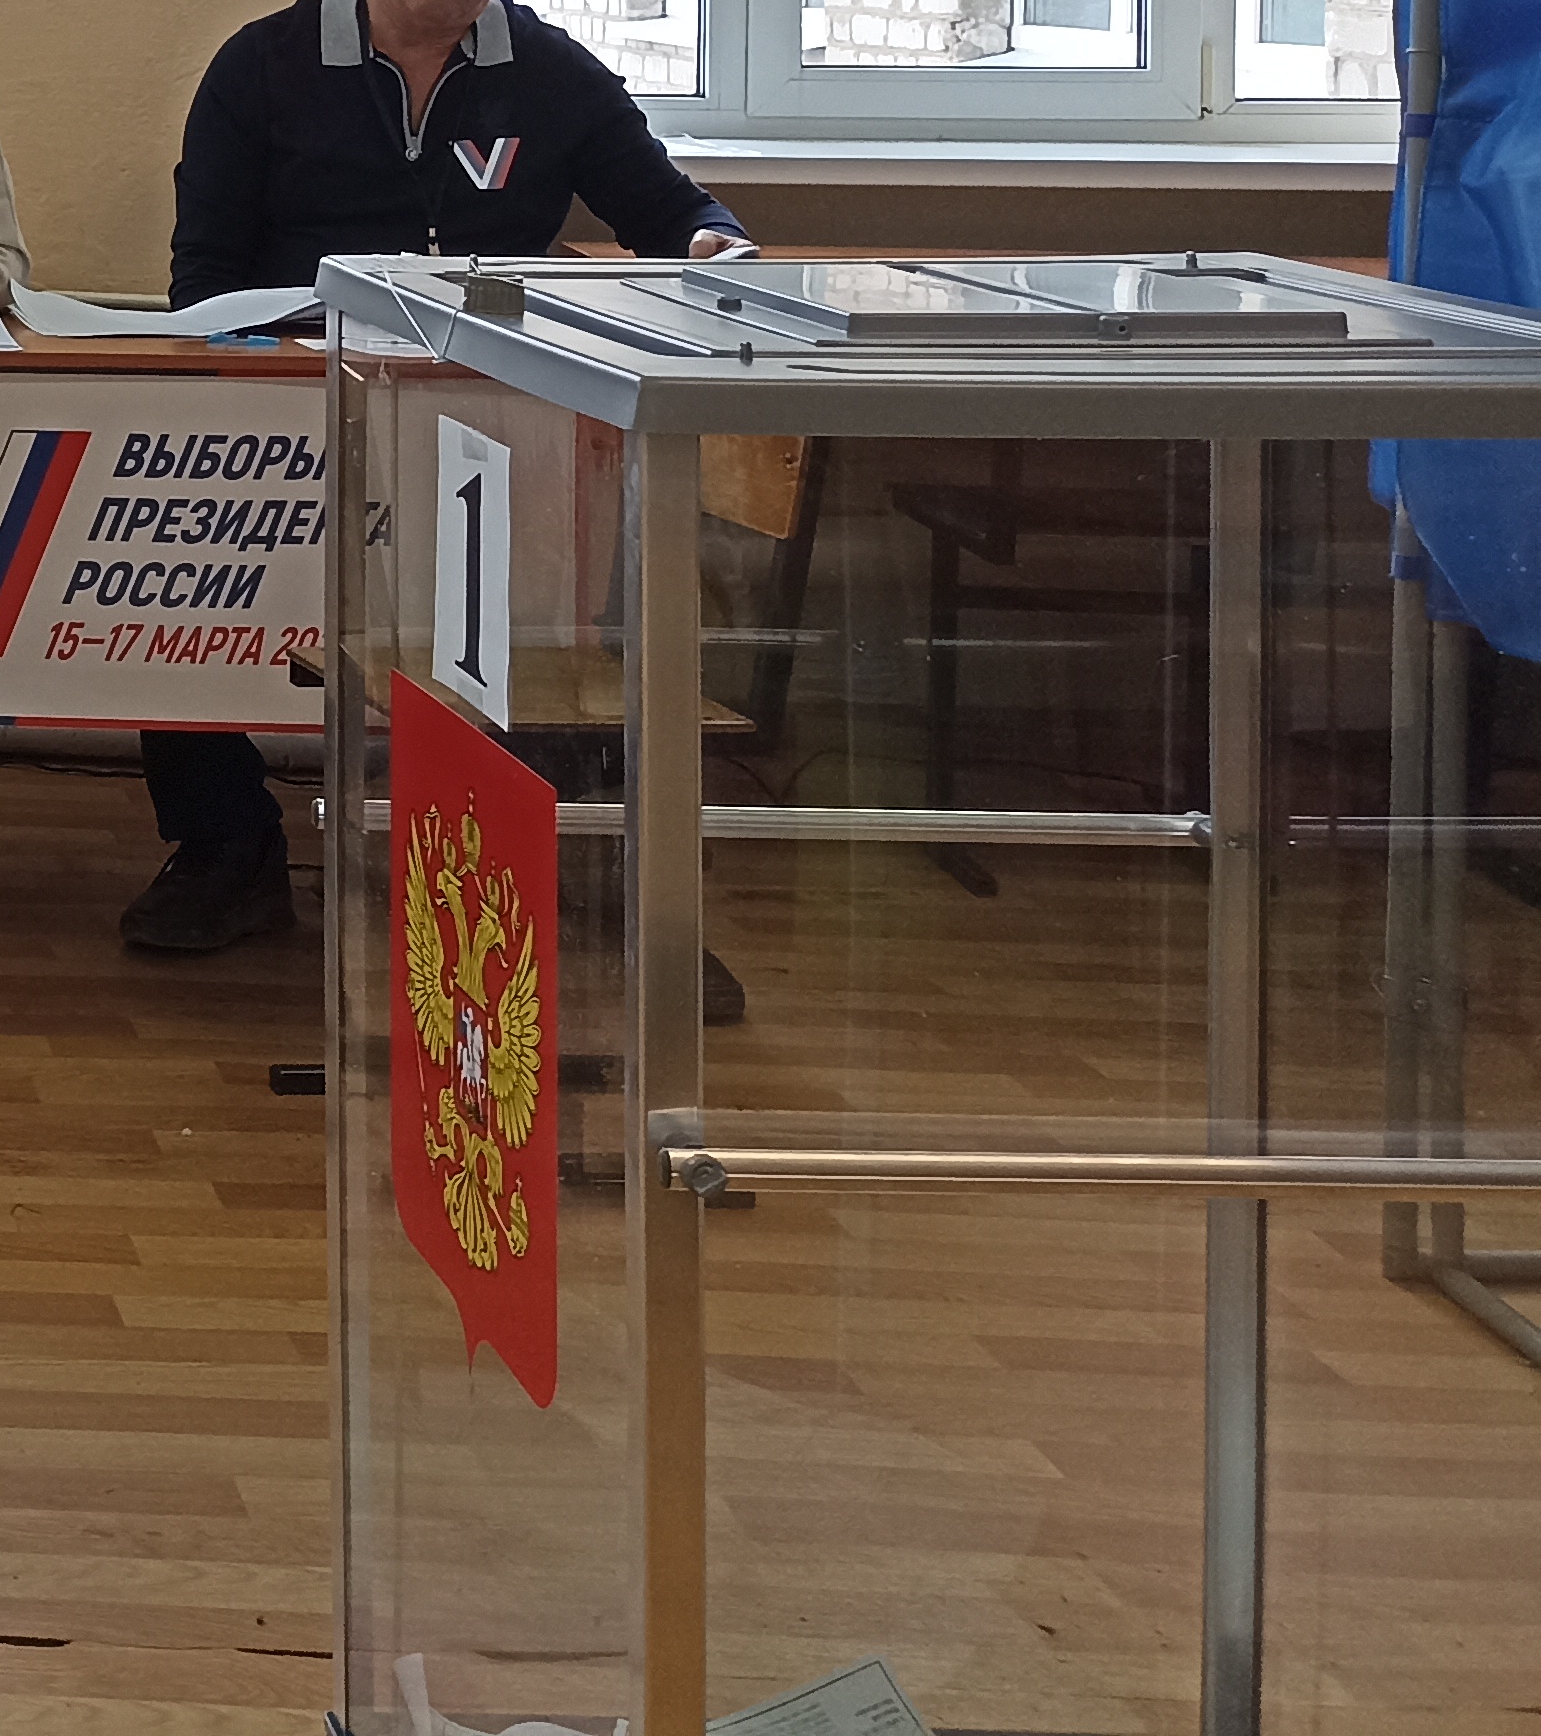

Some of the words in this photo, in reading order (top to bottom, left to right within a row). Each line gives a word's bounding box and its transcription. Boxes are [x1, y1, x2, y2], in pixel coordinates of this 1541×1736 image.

[62, 560, 267, 609] РОССИИ
[455, 473, 489, 687] 1
[143, 625, 266, 666] МАРТА
